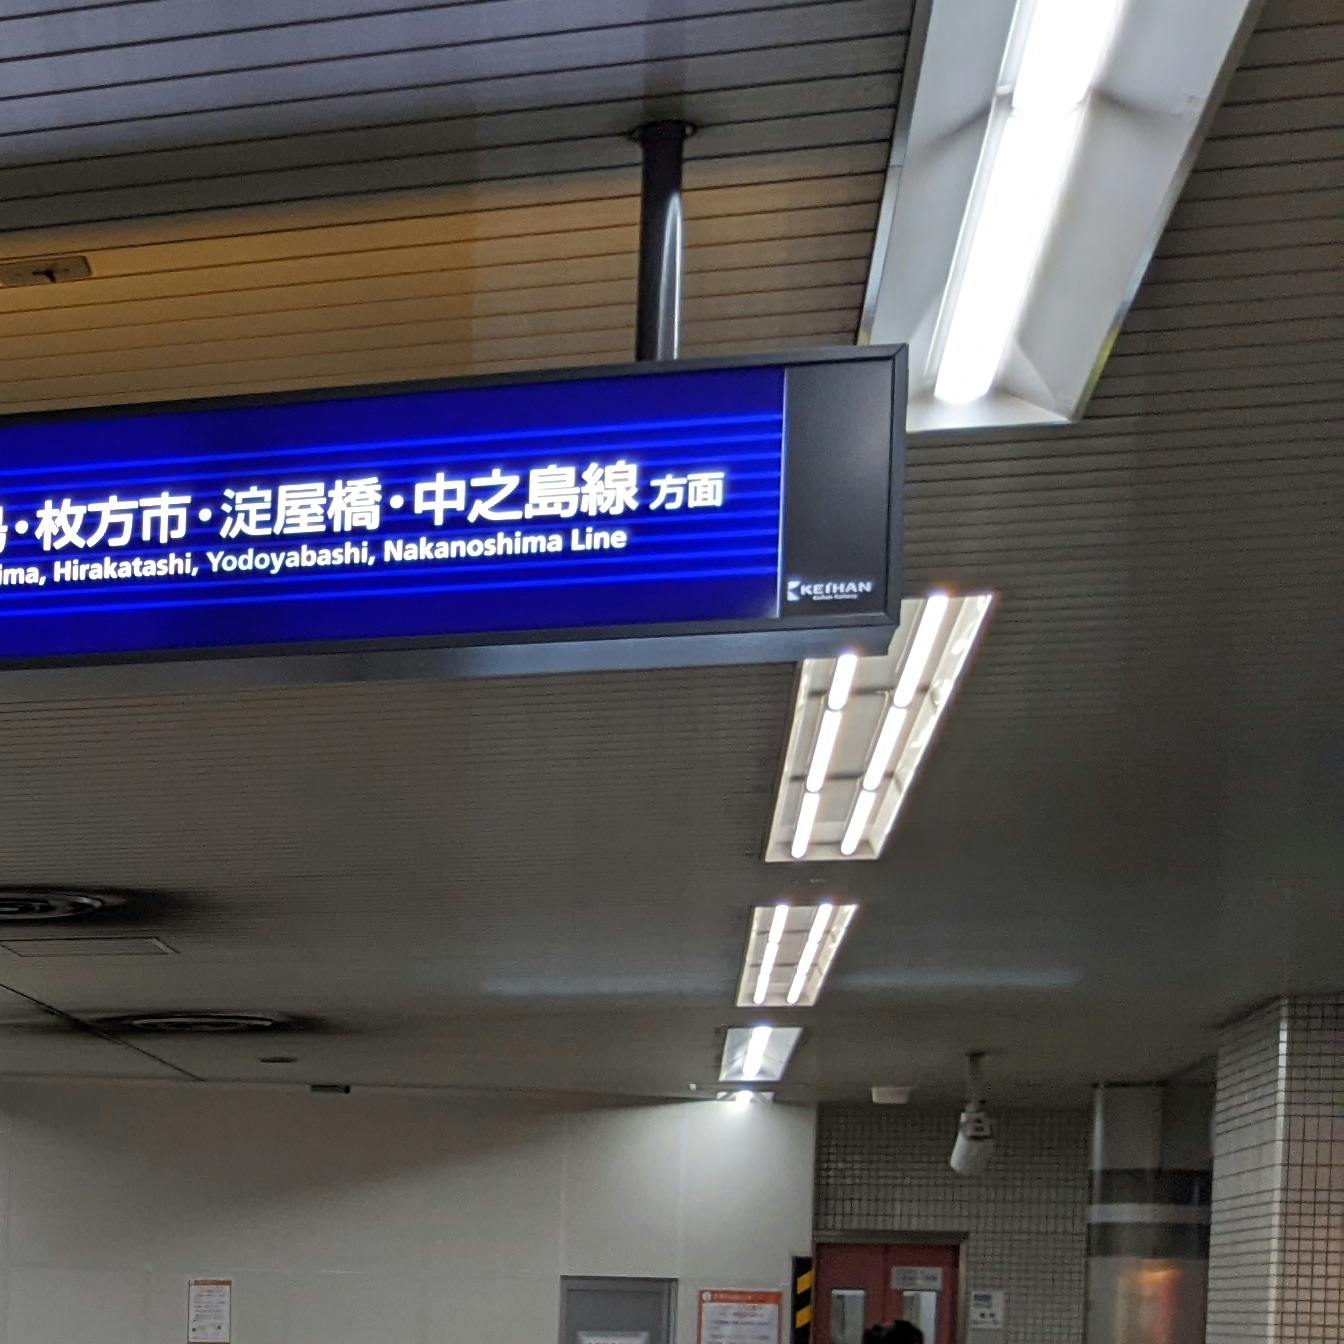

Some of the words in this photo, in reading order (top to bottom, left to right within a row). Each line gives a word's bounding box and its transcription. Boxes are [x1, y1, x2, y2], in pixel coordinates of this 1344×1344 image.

[52, 550, 200, 583] Hirakatashi,
[205, 540, 376, 574] Yodoyabashi,
[383, 528, 563, 558] Nakanoshima
[570, 524, 627, 549] Line
[801, 582, 872, 596] KEIHAN
